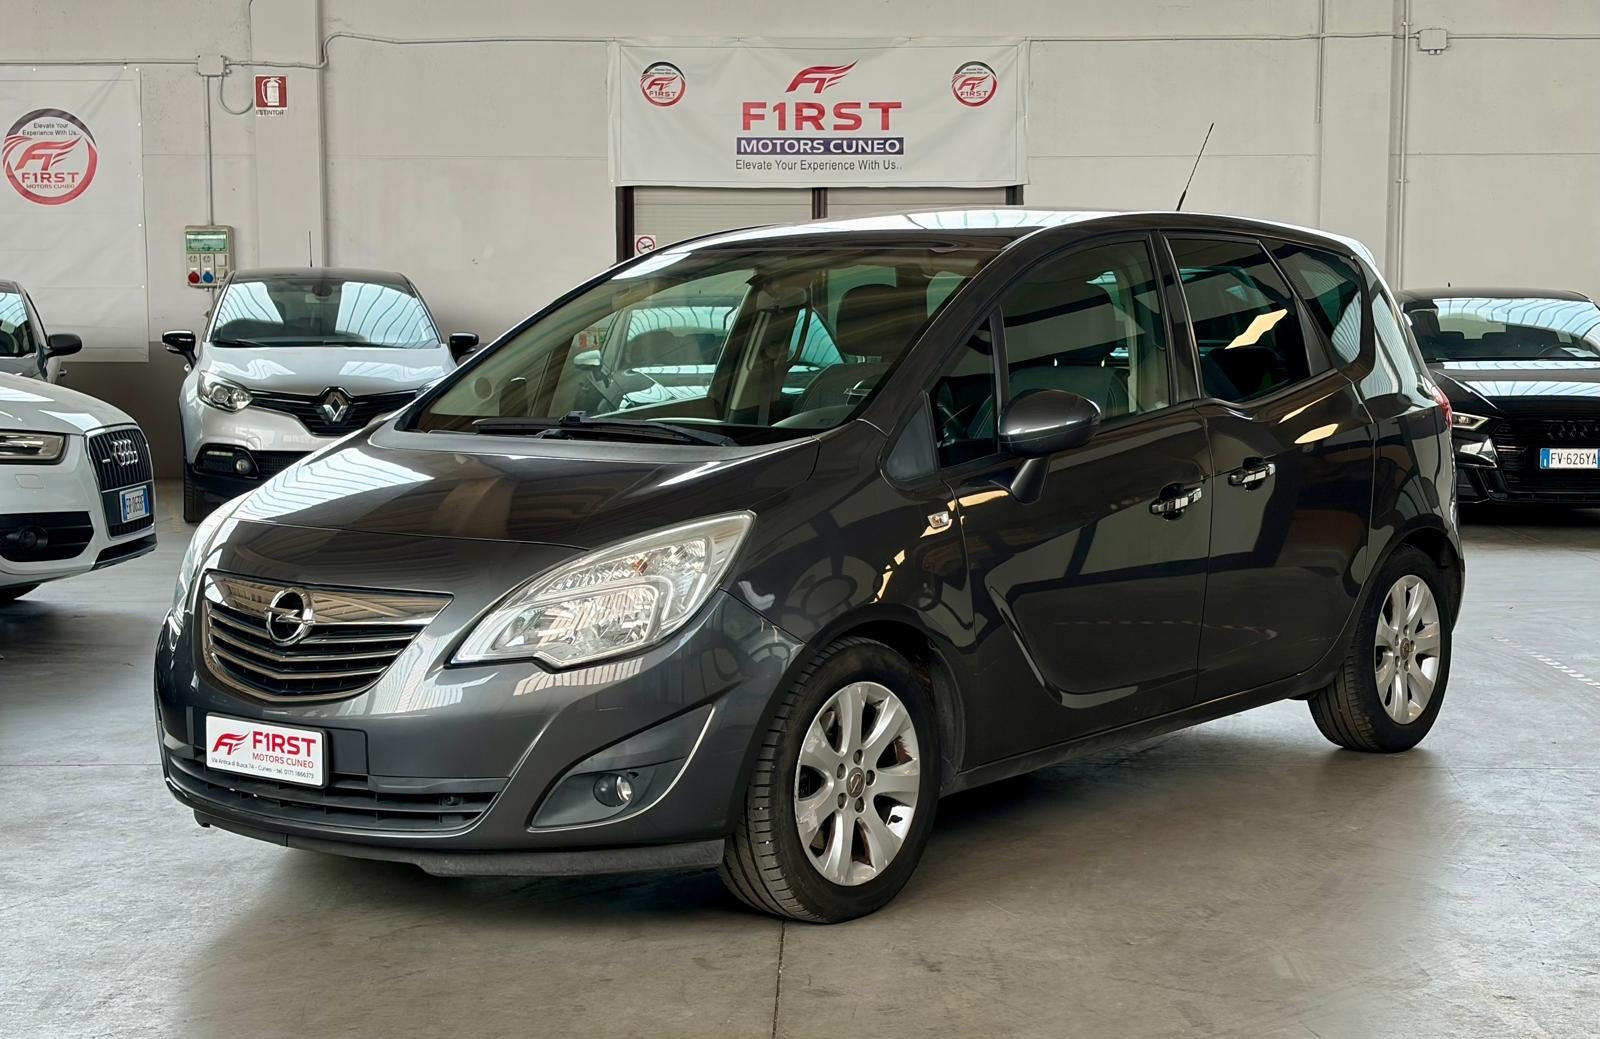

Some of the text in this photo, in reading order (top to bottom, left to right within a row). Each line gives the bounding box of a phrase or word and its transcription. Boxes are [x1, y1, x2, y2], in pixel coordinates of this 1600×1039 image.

[742, 102, 902, 131] F1RST
[740, 139, 900, 153] MOTORS CUNEO
[735, 159, 773, 170] Elevate
[775, 159, 798, 170] Your
[800, 159, 856, 172] Experience
[857, 159, 880, 170] With
[21, 172, 80, 184] F1RST
[252, 731, 316, 757] F1RST
[252, 752, 315, 769] MOTORS CUNEO
